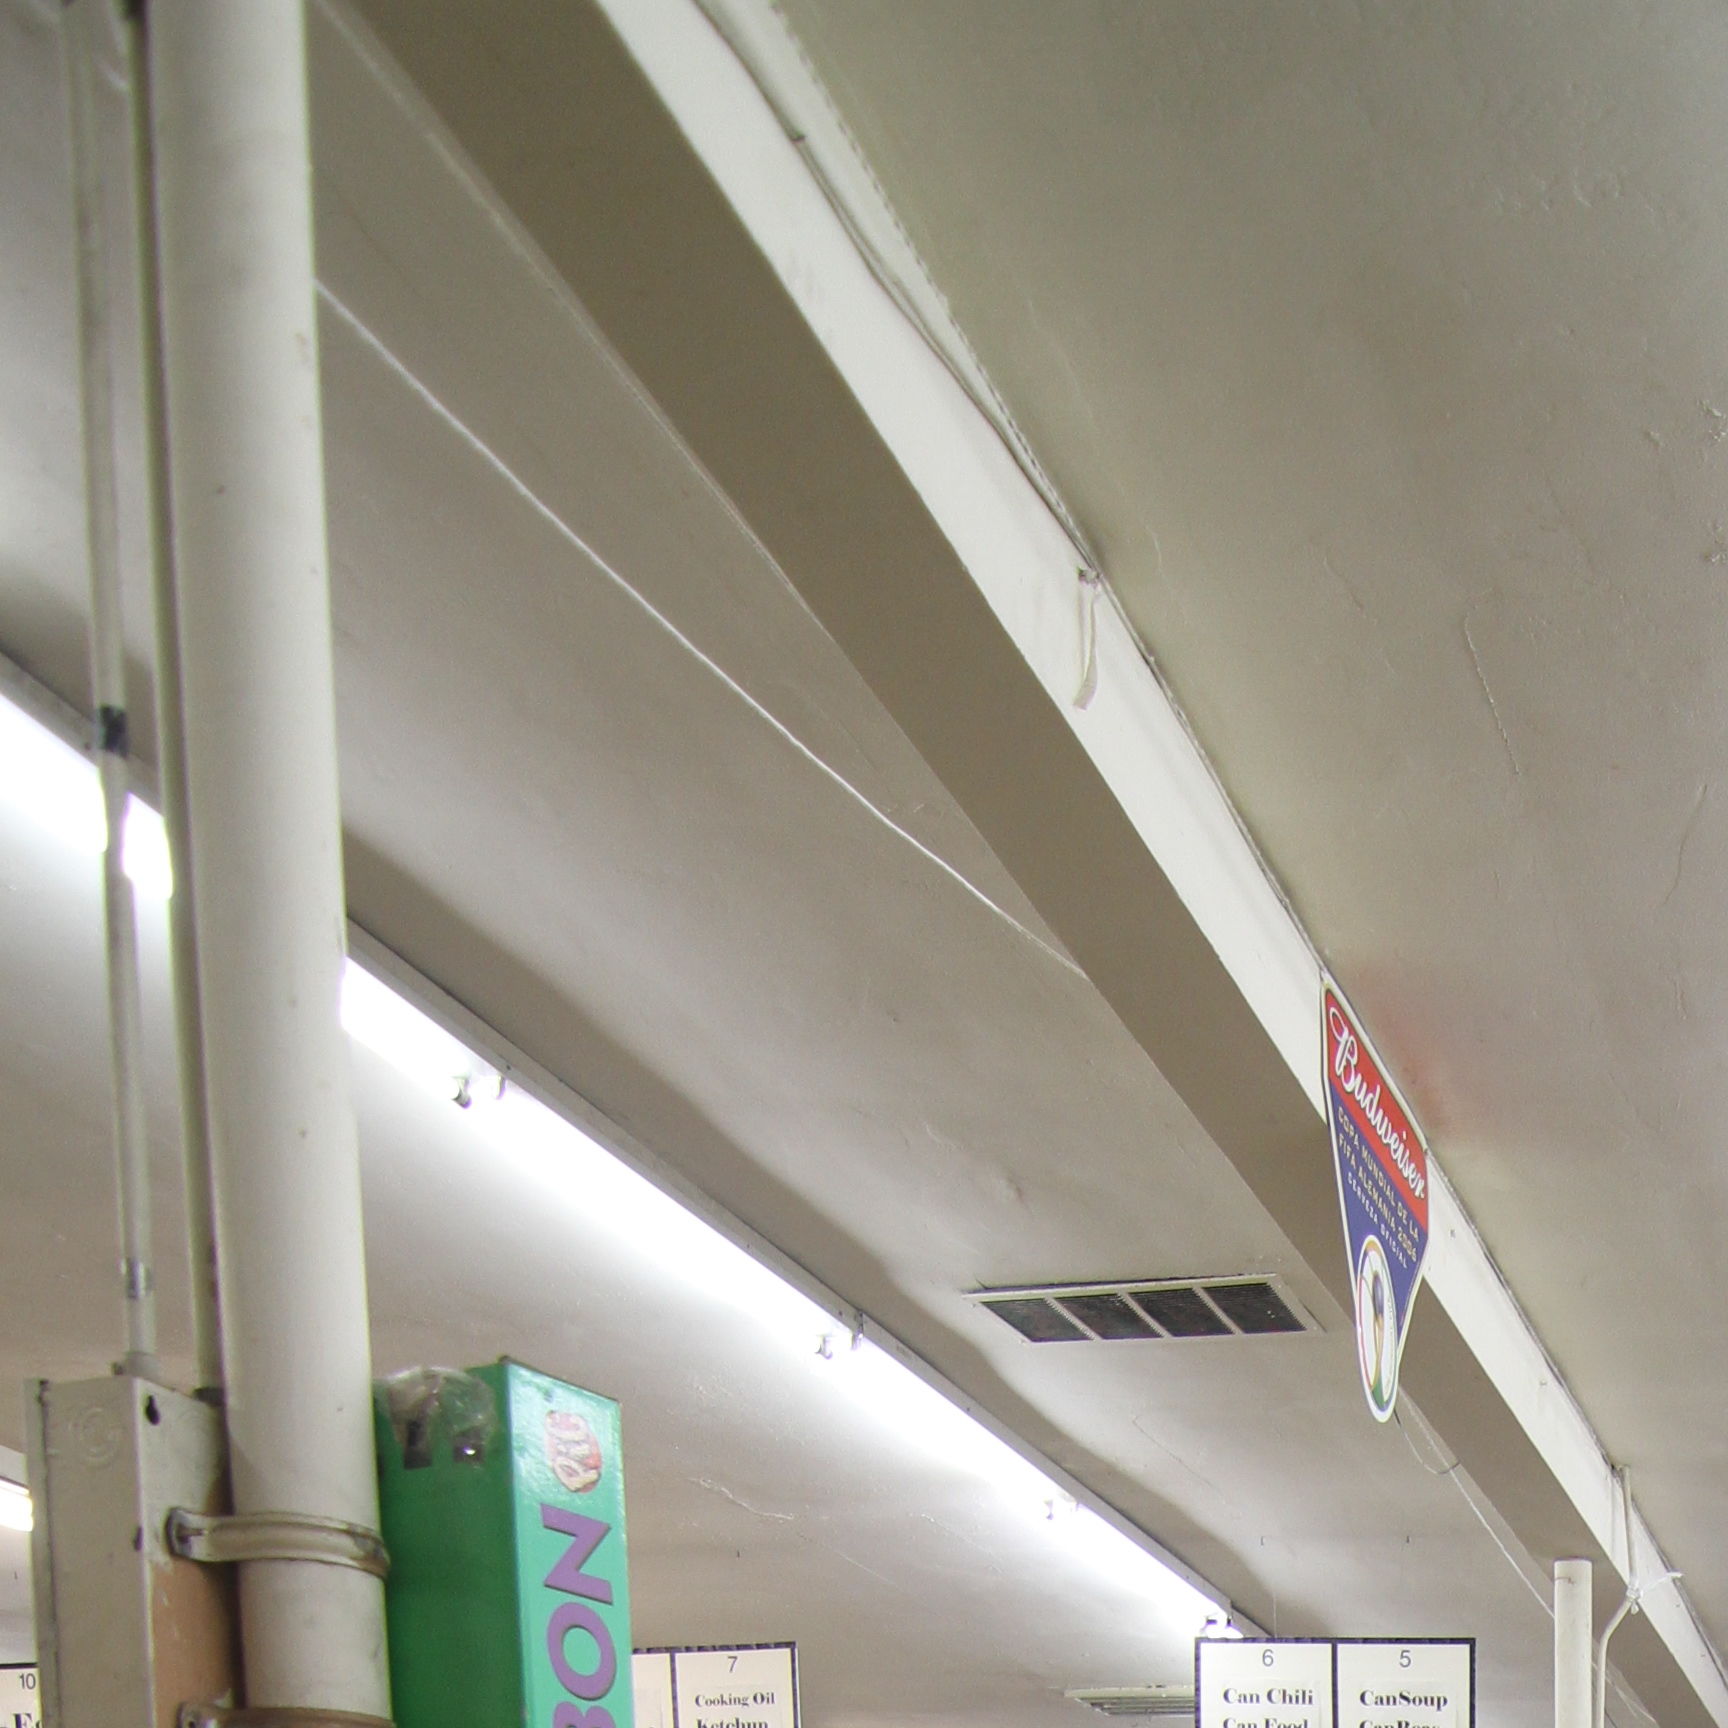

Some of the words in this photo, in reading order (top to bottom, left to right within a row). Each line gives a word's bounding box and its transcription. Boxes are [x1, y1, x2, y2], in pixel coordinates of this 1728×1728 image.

[1329, 1007, 1425, 1199] Budweiser
[1338, 1105, 1360, 1149] COPA
[1361, 1142, 1396, 1207] MUNDIAL
[1396, 1202, 1408, 1226] DE
[1408, 1222, 1420, 1242] LA
[1338, 1134, 1356, 1171] FIFA
[1357, 1168, 1396, 1234] ALEMANIA
[728, 1656, 738, 1673] 7
[1262, 1649, 1274, 1667] 6
[1399, 1650, 1411, 1668] 5
[19, 1673, 36, 1690] 10
[695, 1693, 749, 1707] Cooking
[752, 1692, 775, 1704] Oil
[1223, 1688, 1260, 1705] Can
[1267, 1688, 1313, 1705] Chili
[1359, 1689, 1448, 1711] CanSoup
